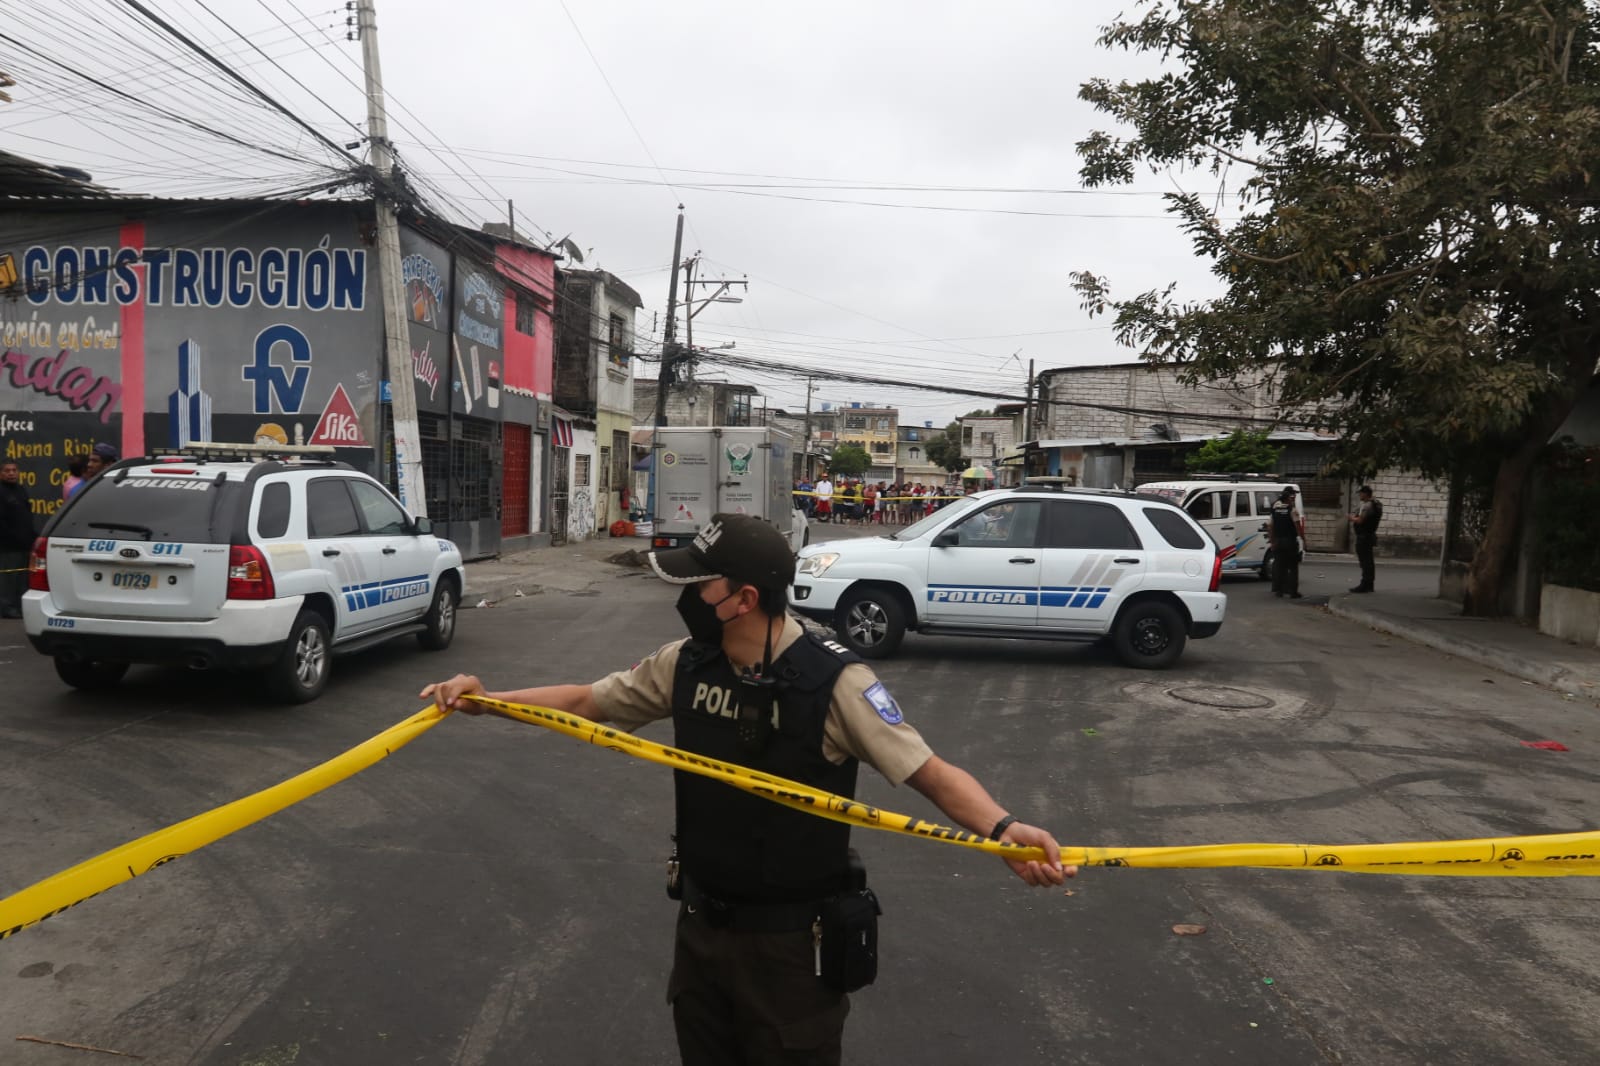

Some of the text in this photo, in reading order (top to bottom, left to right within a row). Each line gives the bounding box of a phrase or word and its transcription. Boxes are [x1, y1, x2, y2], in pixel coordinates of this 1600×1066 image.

[23, 234, 366, 311] CONSTRUCCIÓN
[0, 311, 52, 348] ería
[0, 349, 121, 424] rdan
[6, 440, 53, 459] Arena
[116, 478, 211, 491] POLICIA
[88, 540, 116, 552] ECU
[152, 543, 183, 556] 911
[112, 572, 151, 588] 01729
[385, 582, 427, 600] POLICIA
[932, 591, 1027, 604] POLICIA
[47, 617, 75, 629] 01729
